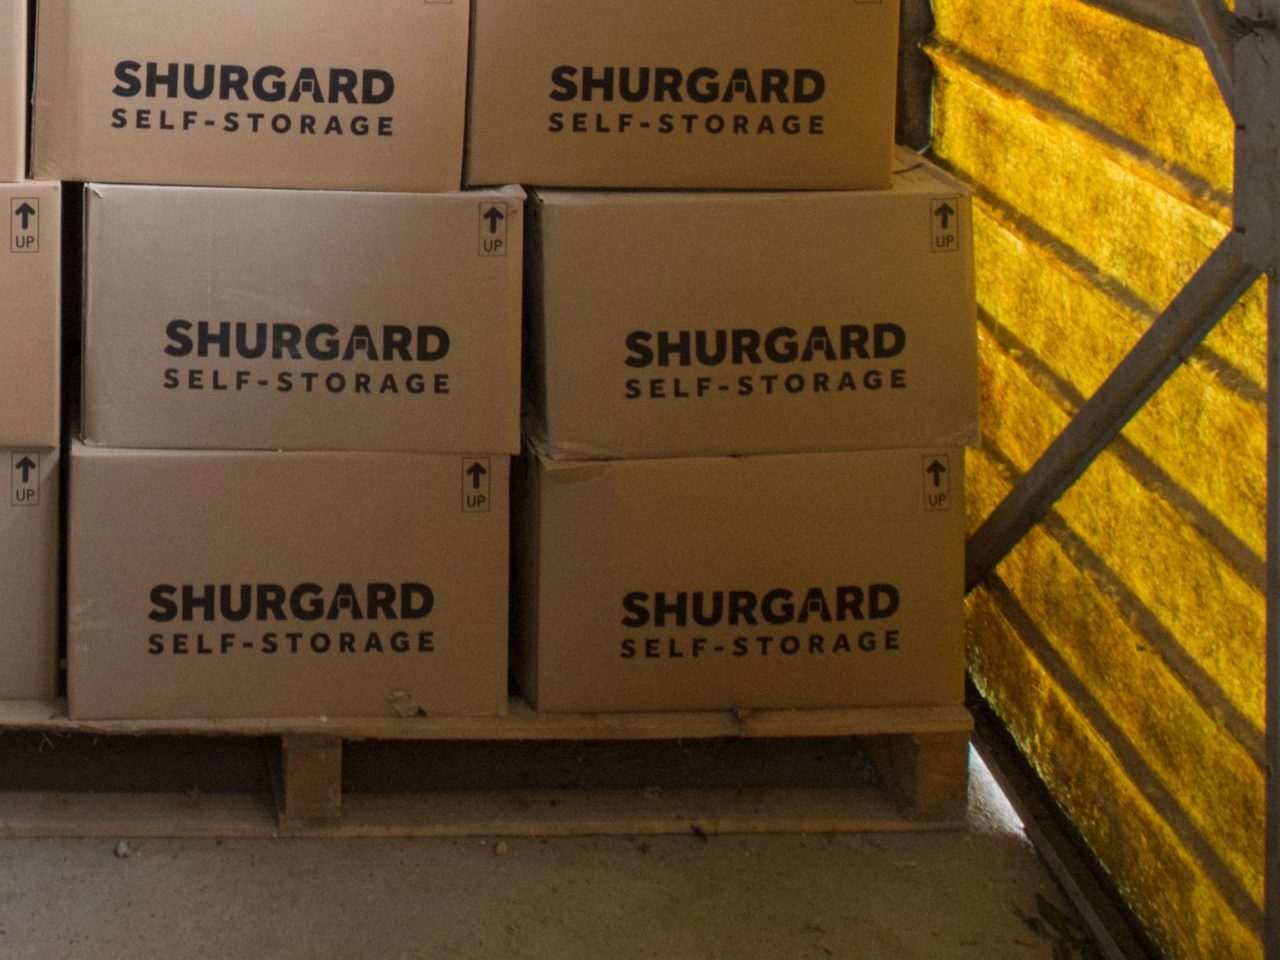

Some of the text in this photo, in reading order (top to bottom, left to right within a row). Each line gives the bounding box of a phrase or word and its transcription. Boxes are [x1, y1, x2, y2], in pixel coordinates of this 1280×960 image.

[112, 60, 395, 105] SHURGARD
[549, 65, 826, 104] SHURGARD
[111, 108, 394, 137] SELF-STORAGE
[548, 112, 824, 135] SELF-STORAGE
[15, 235, 34, 248] UP
[484, 239, 503, 253] UP
[935, 235, 954, 249] UP
[164, 319, 451, 362] SHURGARD
[624, 322, 907, 368] SHURGARD
[163, 368, 450, 395] SELF-STORAGE
[624, 368, 907, 400] SELF-STORAGE
[16, 489, 35, 502] UP
[467, 495, 486, 509] UP
[928, 493, 947, 506] UP
[147, 582, 435, 623] SHURGARD
[620, 583, 900, 628] SHURGARD
[148, 630, 435, 655] SELF-STORAGE
[620, 629, 900, 659] SELF-STORAGE
